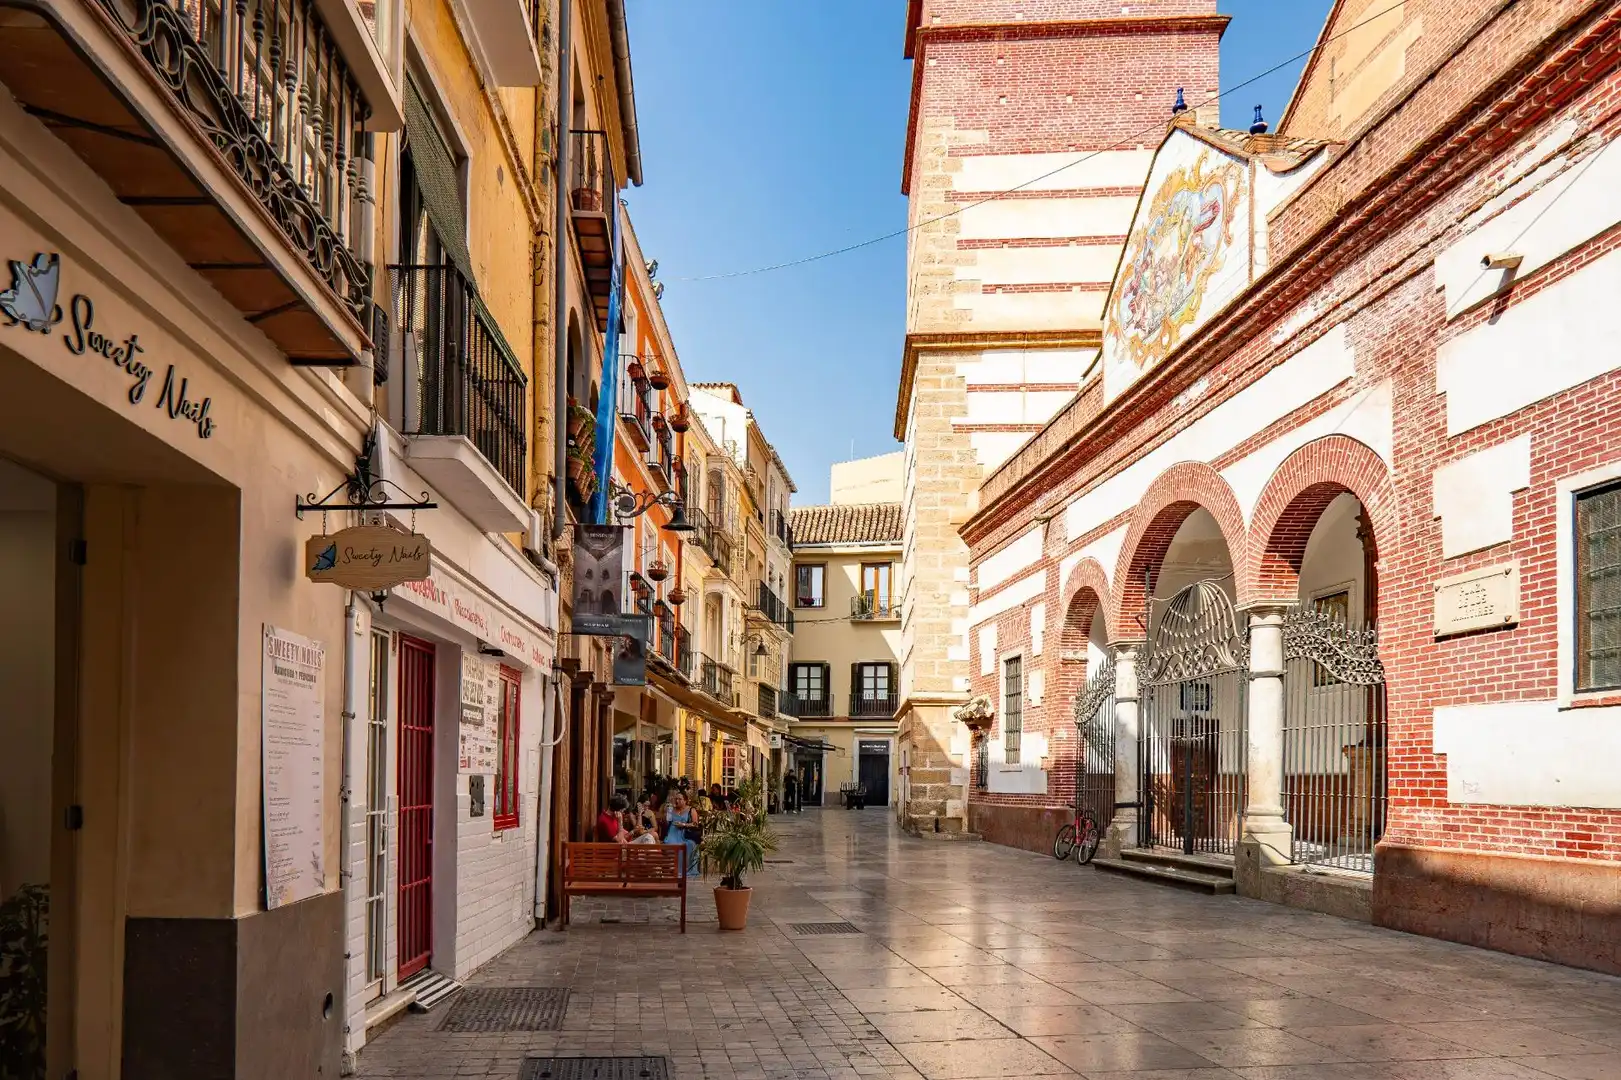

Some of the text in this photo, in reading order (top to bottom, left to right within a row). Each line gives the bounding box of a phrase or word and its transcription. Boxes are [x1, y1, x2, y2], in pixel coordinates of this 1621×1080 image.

[64, 293, 217, 439] Sweety Nails
[342, 545, 424, 567] Sweety Nails
[268, 636, 322, 668] SWEETY NAILS
